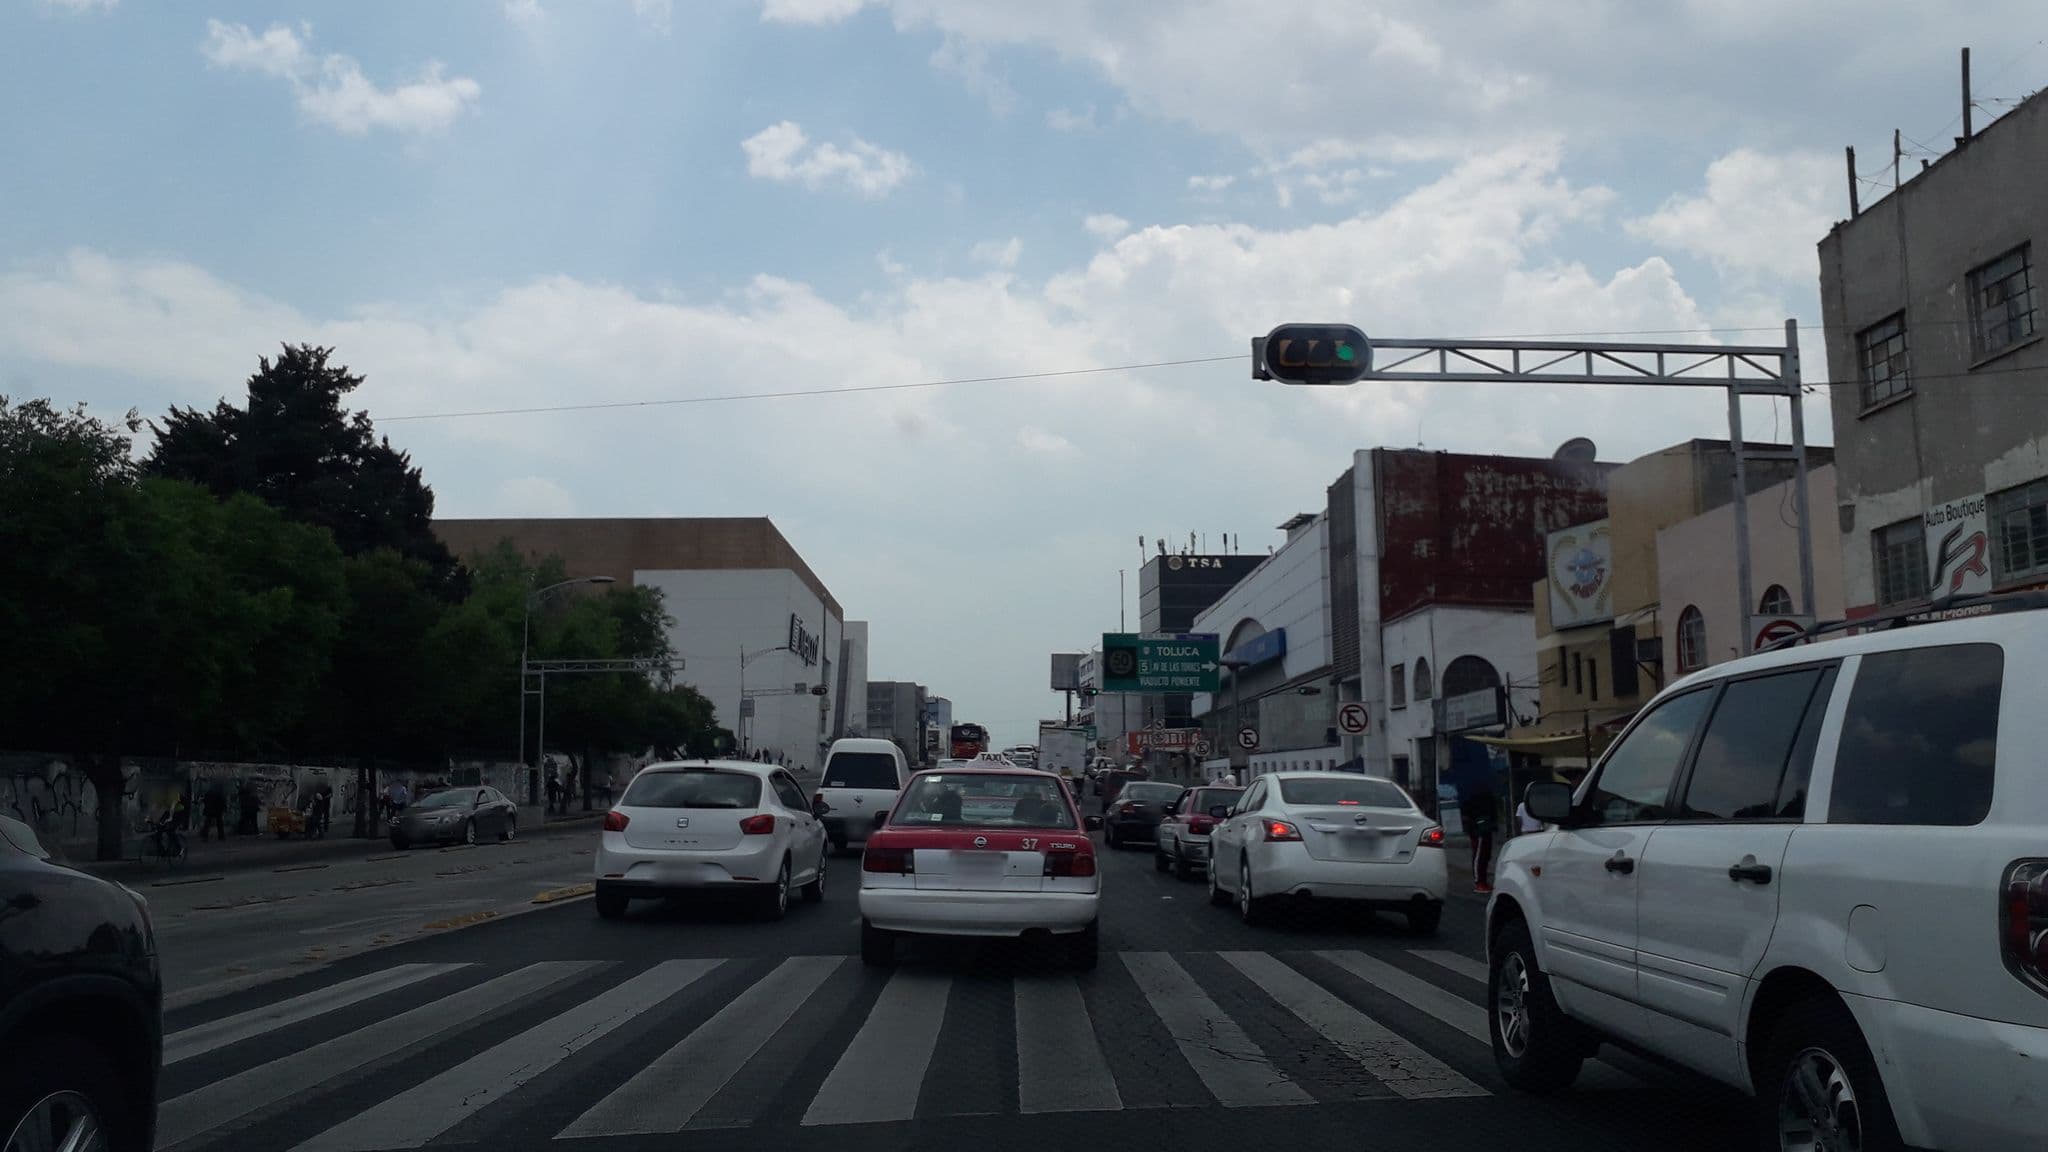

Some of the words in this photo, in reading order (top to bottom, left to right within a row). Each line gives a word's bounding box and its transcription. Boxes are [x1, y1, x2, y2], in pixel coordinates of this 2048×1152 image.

[1925, 510, 1945, 529] Auto
[1945, 499, 1985, 520] Boutique
[1187, 558, 1222, 568] TSA
[1157, 647, 1199, 656] TOLUCA
[1141, 662, 1148, 672] 5
[1169, 662, 1180, 672] LAS
[980, 753, 1002, 762] TAXI
[1021, 838, 1039, 850] 37
